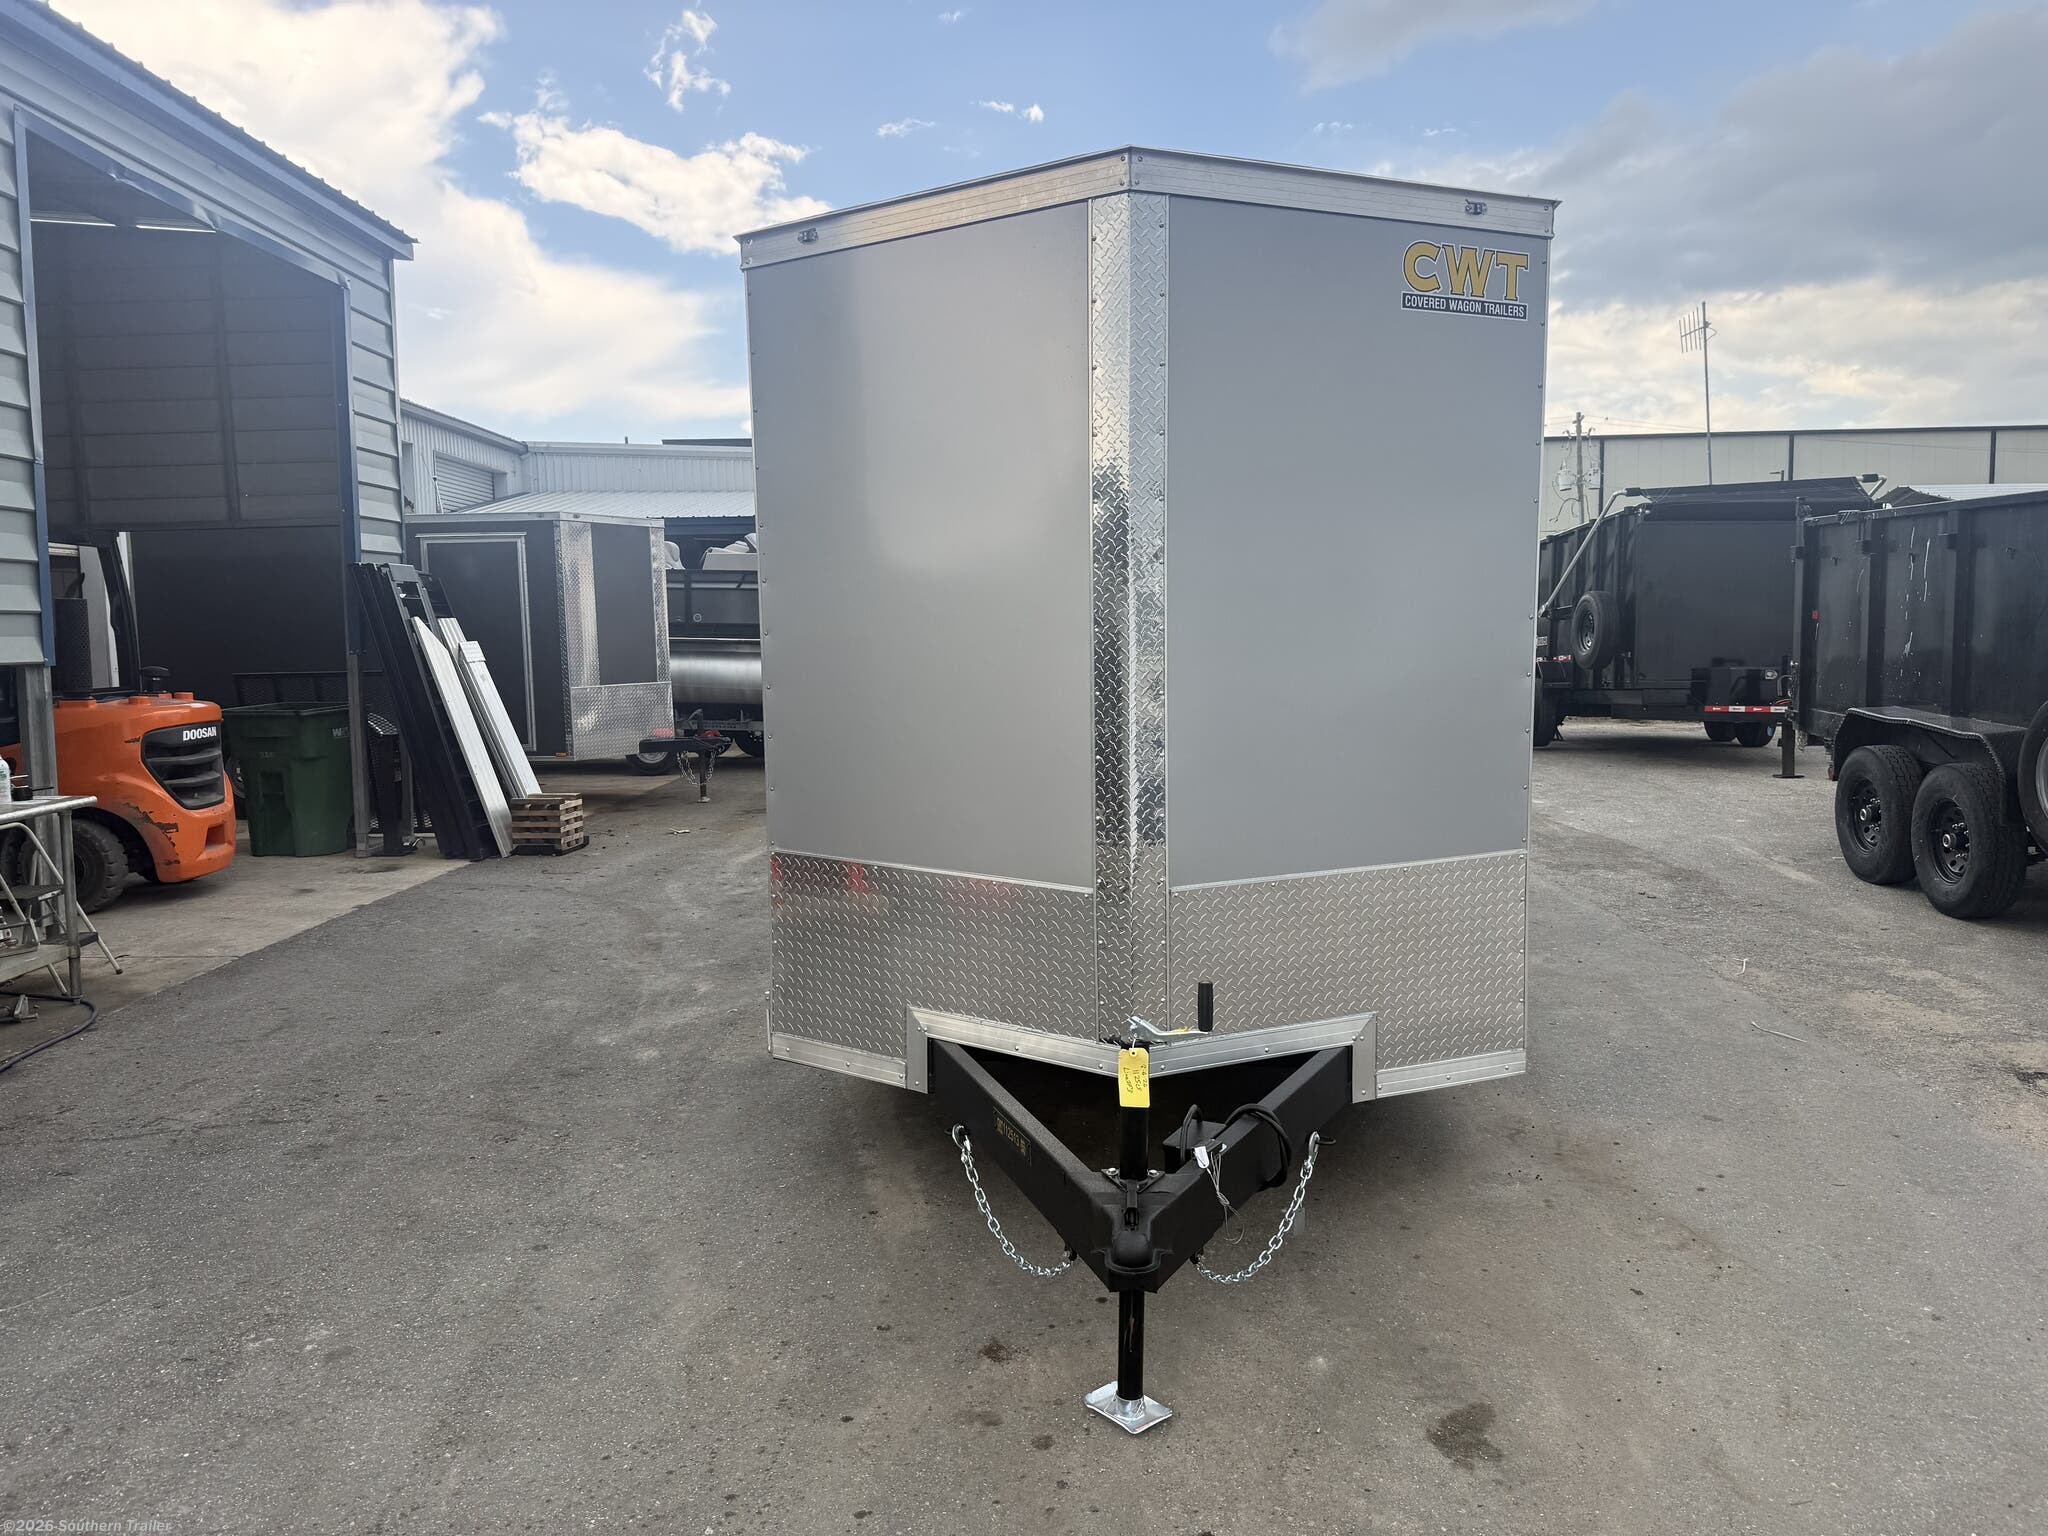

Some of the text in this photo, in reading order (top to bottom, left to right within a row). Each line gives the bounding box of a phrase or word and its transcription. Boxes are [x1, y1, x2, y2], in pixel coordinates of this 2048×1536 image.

[1402, 240, 1529, 302] CWT
[1404, 294, 1525, 317] COVERED WAGON TRAILERS
[182, 726, 217, 742] DOOSAN
